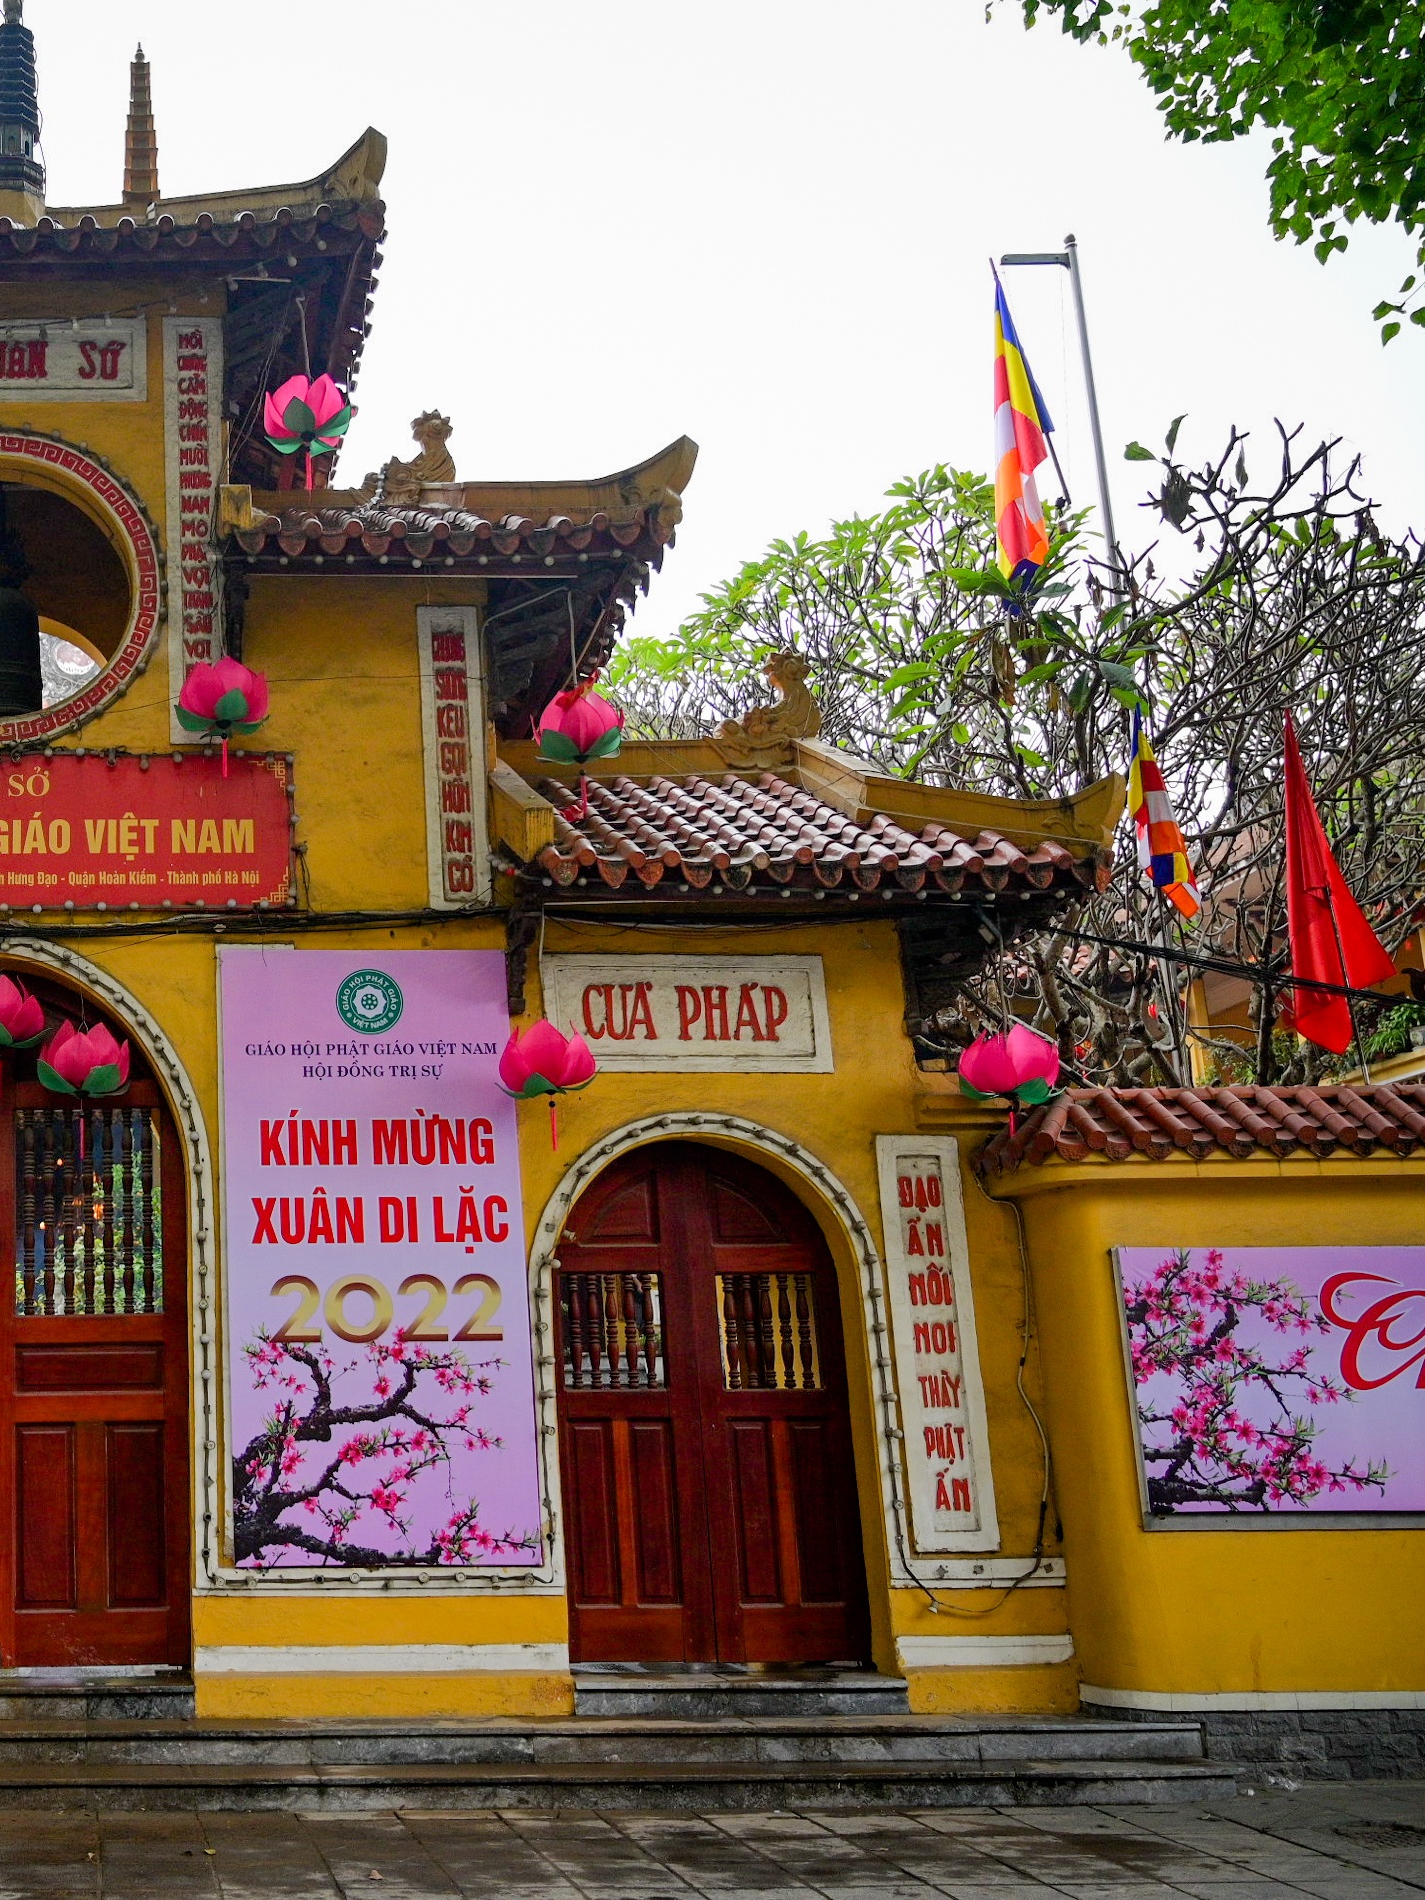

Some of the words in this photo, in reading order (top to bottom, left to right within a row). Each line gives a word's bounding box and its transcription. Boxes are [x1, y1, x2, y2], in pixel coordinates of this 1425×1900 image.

[79, 341, 125, 381] SỨ
[8, 766, 49, 796] SỞ
[84, 811, 159, 863] VIỆT
[170, 818, 256, 854] NAM
[7, 871, 34, 886] Hưng
[37, 871, 58, 887] Đạo
[69, 871, 95, 887] Quận
[99, 871, 126, 884] Hoàn
[129, 868, 156, 885] Kiếm
[167, 870, 198, 884] Thành
[202, 868, 222, 886] phố
[225, 870, 238, 884] Hà
[242, 870, 259, 886] Nội
[370, 1017, 389, 1029] NAM
[674, 982, 788, 1041] PHÁP
[245, 1041, 286, 1056] GIÁO
[290, 1040, 321, 1058] HỘI
[326, 1040, 369, 1058] PHẬT
[374, 1040, 414, 1055] GIÁO
[419, 1040, 457, 1057] VIỆT
[461, 1043, 497, 1055] NAM
[303, 1062, 333, 1080] HỘI
[337, 1060, 385, 1078] ĐỒNG
[389, 1065, 417, 1080] TRỊ
[421, 1064, 444, 1080] SỰ
[259, 1109, 358, 1166] KÍNH
[371, 1108, 495, 1166] MỪNG
[251, 1186, 365, 1244] XUÂN
[378, 1196, 418, 1244] DI
[432, 1185, 510, 1254] LẶC
[909, 1262, 953, 1305] NỐI
[269, 1274, 504, 1342] 2022
[914, 1323, 956, 1354] NOI
[925, 1424, 964, 1464] PHẬT
[937, 1462, 972, 1511] ẤN
